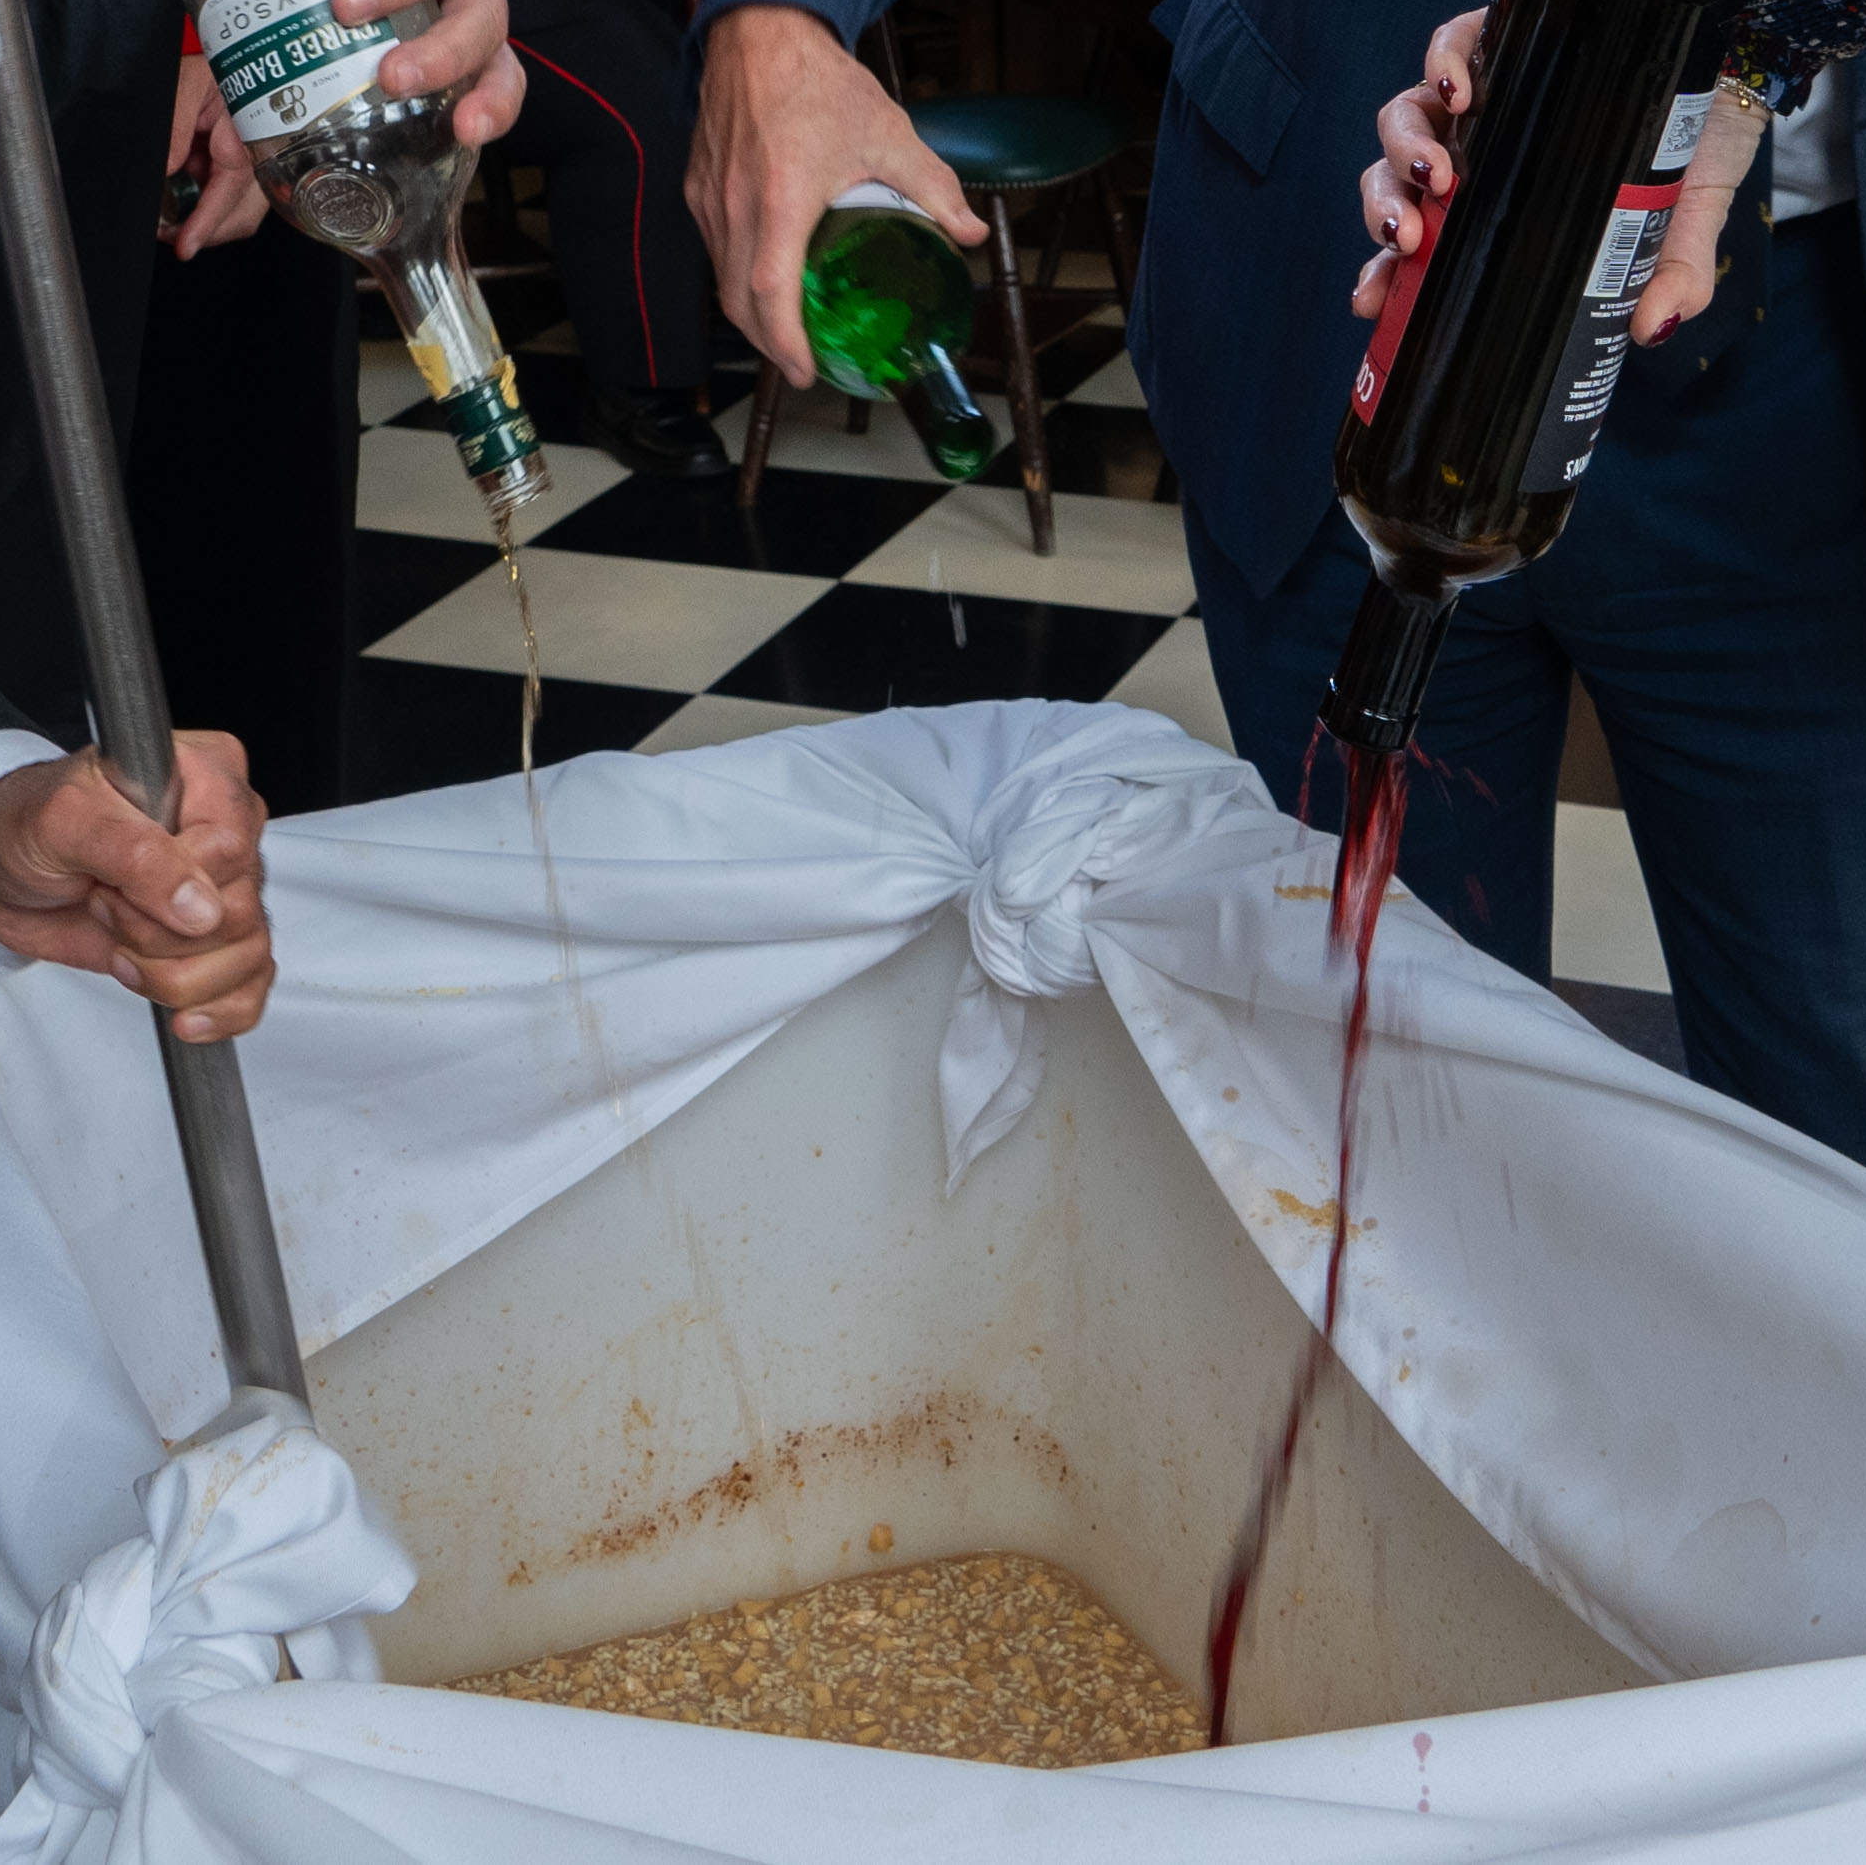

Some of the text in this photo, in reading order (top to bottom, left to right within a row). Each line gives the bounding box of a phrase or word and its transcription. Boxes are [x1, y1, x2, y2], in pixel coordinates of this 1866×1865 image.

[279, 21, 301, 36] OLD
[243, 33, 279, 54] FRENCH
[284, 20, 383, 68] THREE
[311, 71, 342, 88] SINCE
